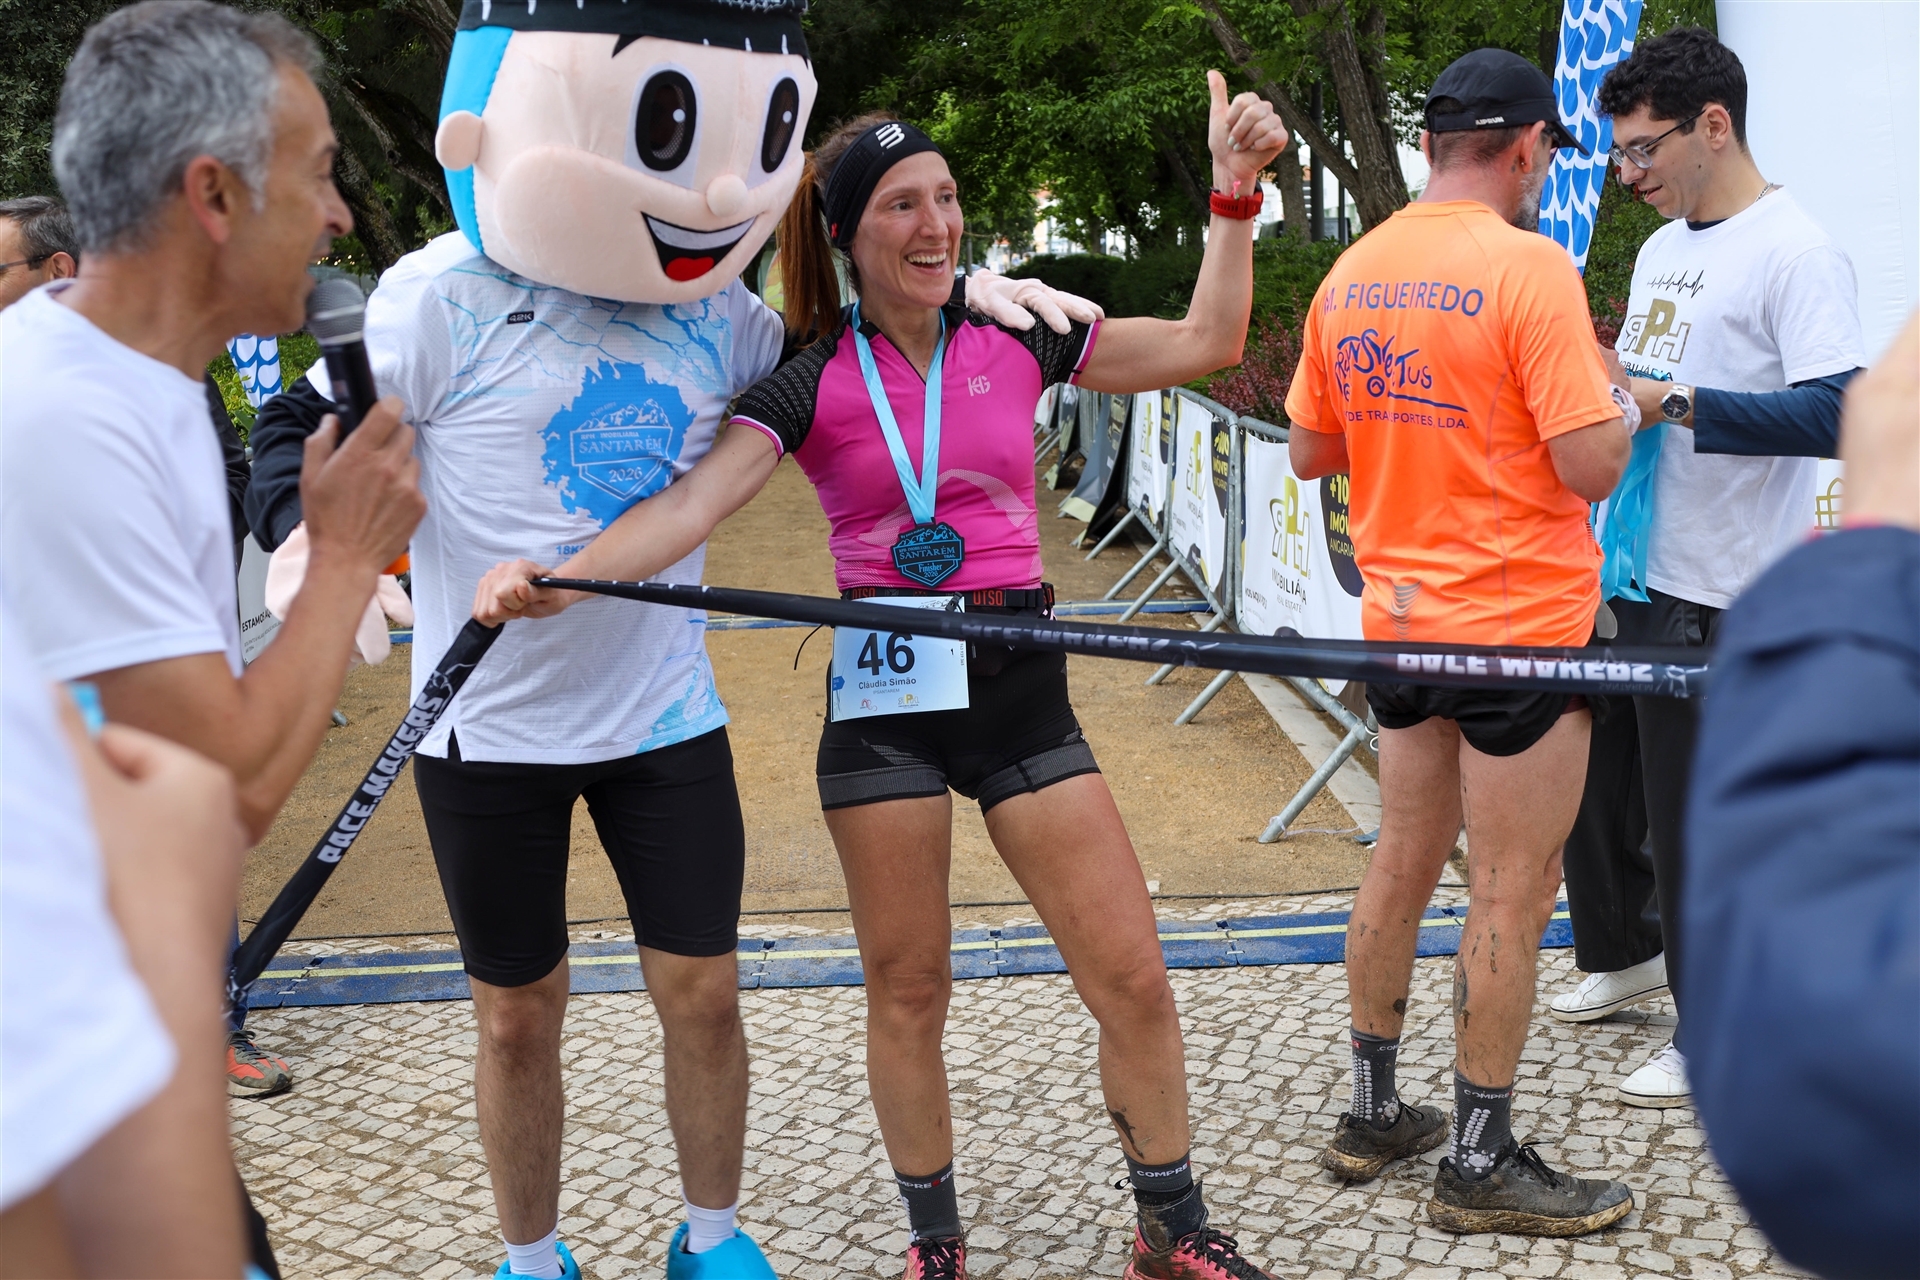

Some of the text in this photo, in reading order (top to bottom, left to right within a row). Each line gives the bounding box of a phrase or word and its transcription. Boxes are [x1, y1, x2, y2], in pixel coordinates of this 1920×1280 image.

[1345, 282, 1483, 317] FIGUEIREDO
[509, 312, 532, 322] 42K
[1438, 417, 1470, 429] LDA.
[579, 436, 662, 454] SANTARÉM
[609, 466, 643, 483] 2026
[899, 546, 956, 560] SANTARÉM
[918, 562, 943, 573] Finisher
[973, 589, 1003, 606] OTSO
[857, 631, 916, 676] 46
[858, 677, 917, 690] Cláudia Simão
[317, 694, 443, 863] PACE MAKERS
